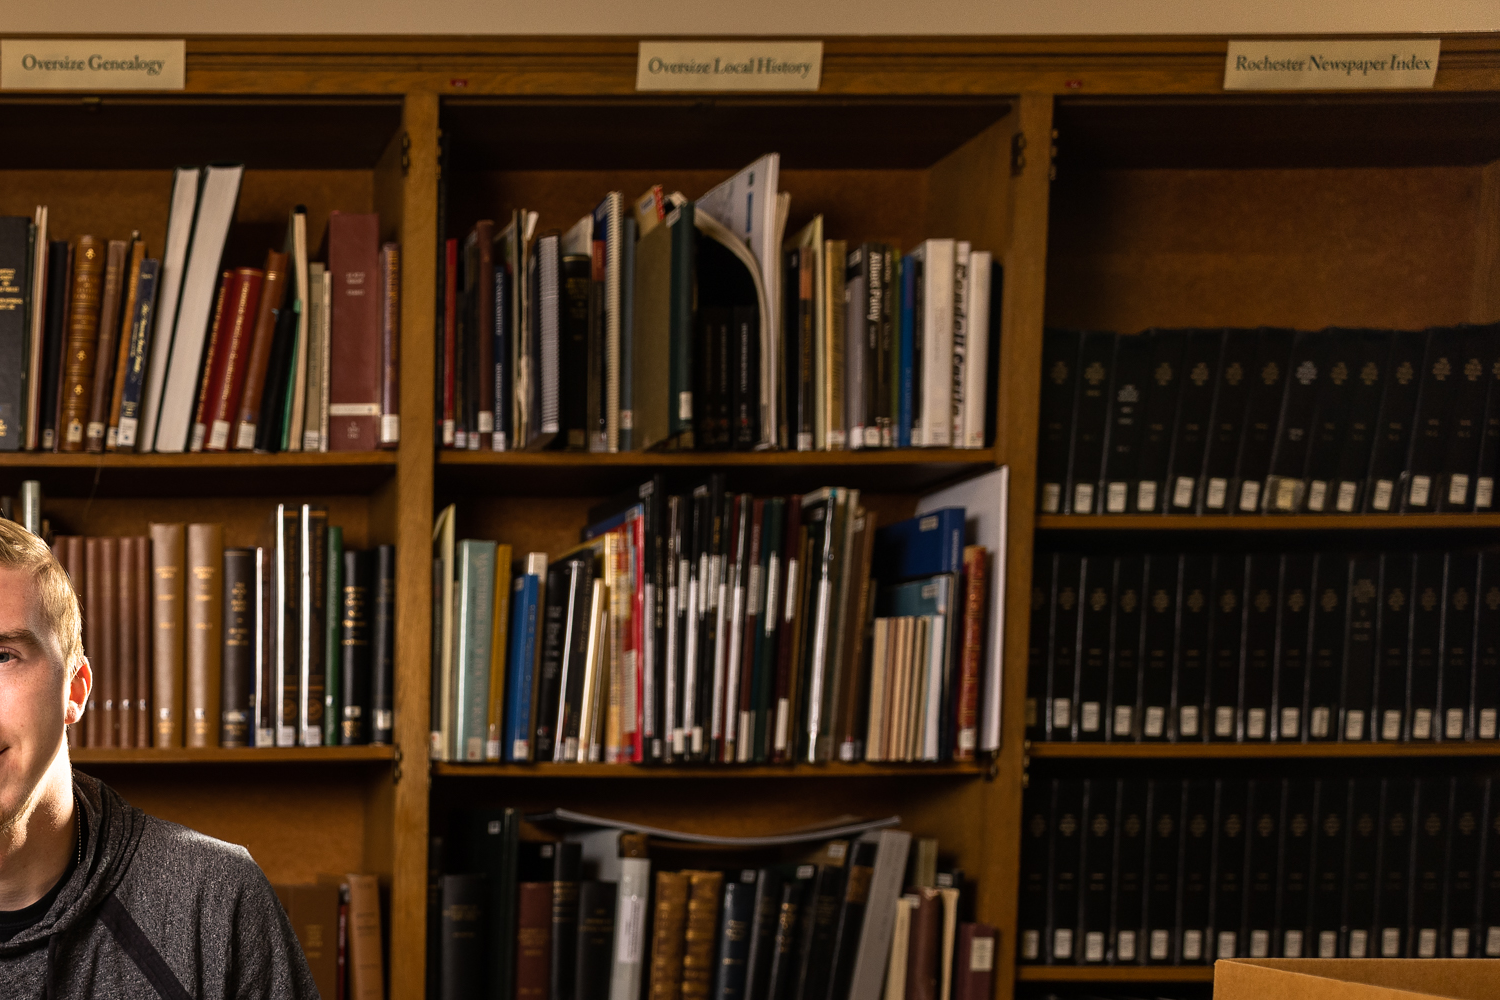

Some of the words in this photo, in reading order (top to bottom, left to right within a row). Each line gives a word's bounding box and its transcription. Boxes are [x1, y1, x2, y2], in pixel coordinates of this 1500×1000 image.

[21, 54, 86, 71] Oversize
[88, 54, 165, 76] Genealogy
[648, 56, 711, 74] Oversize
[713, 56, 755, 74] Local
[757, 57, 812, 79] History
[1235, 54, 1305, 71] Rochester
[1307, 54, 1388, 76] Newspaper
[1389, 54, 1431, 71] Index
[868, 251, 881, 288] Albert
[866, 289, 881, 322] Paley
